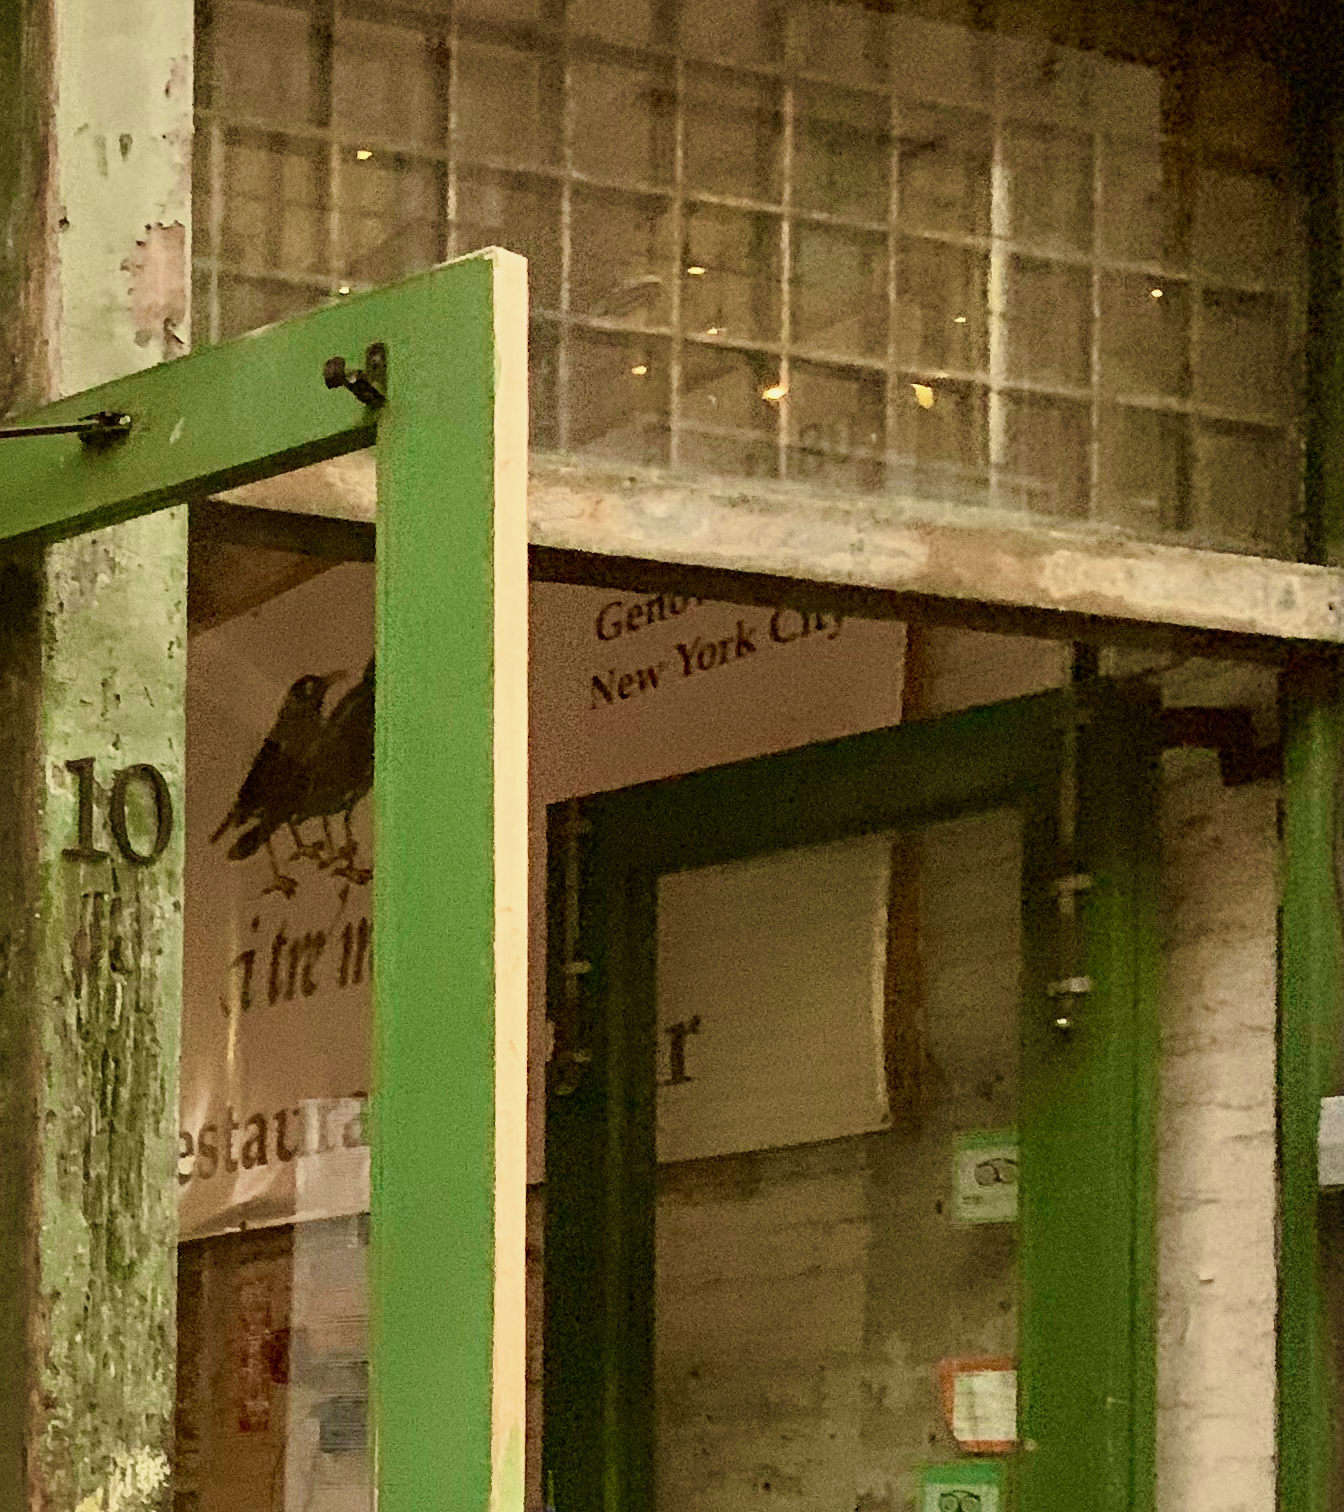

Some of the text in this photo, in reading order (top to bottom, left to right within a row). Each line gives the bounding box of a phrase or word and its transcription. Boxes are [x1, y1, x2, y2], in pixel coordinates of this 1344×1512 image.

[595, 597, 704, 641] Geno
[590, 668, 665, 710] New
[675, 620, 756, 677] York
[61, 756, 173, 868] 10
